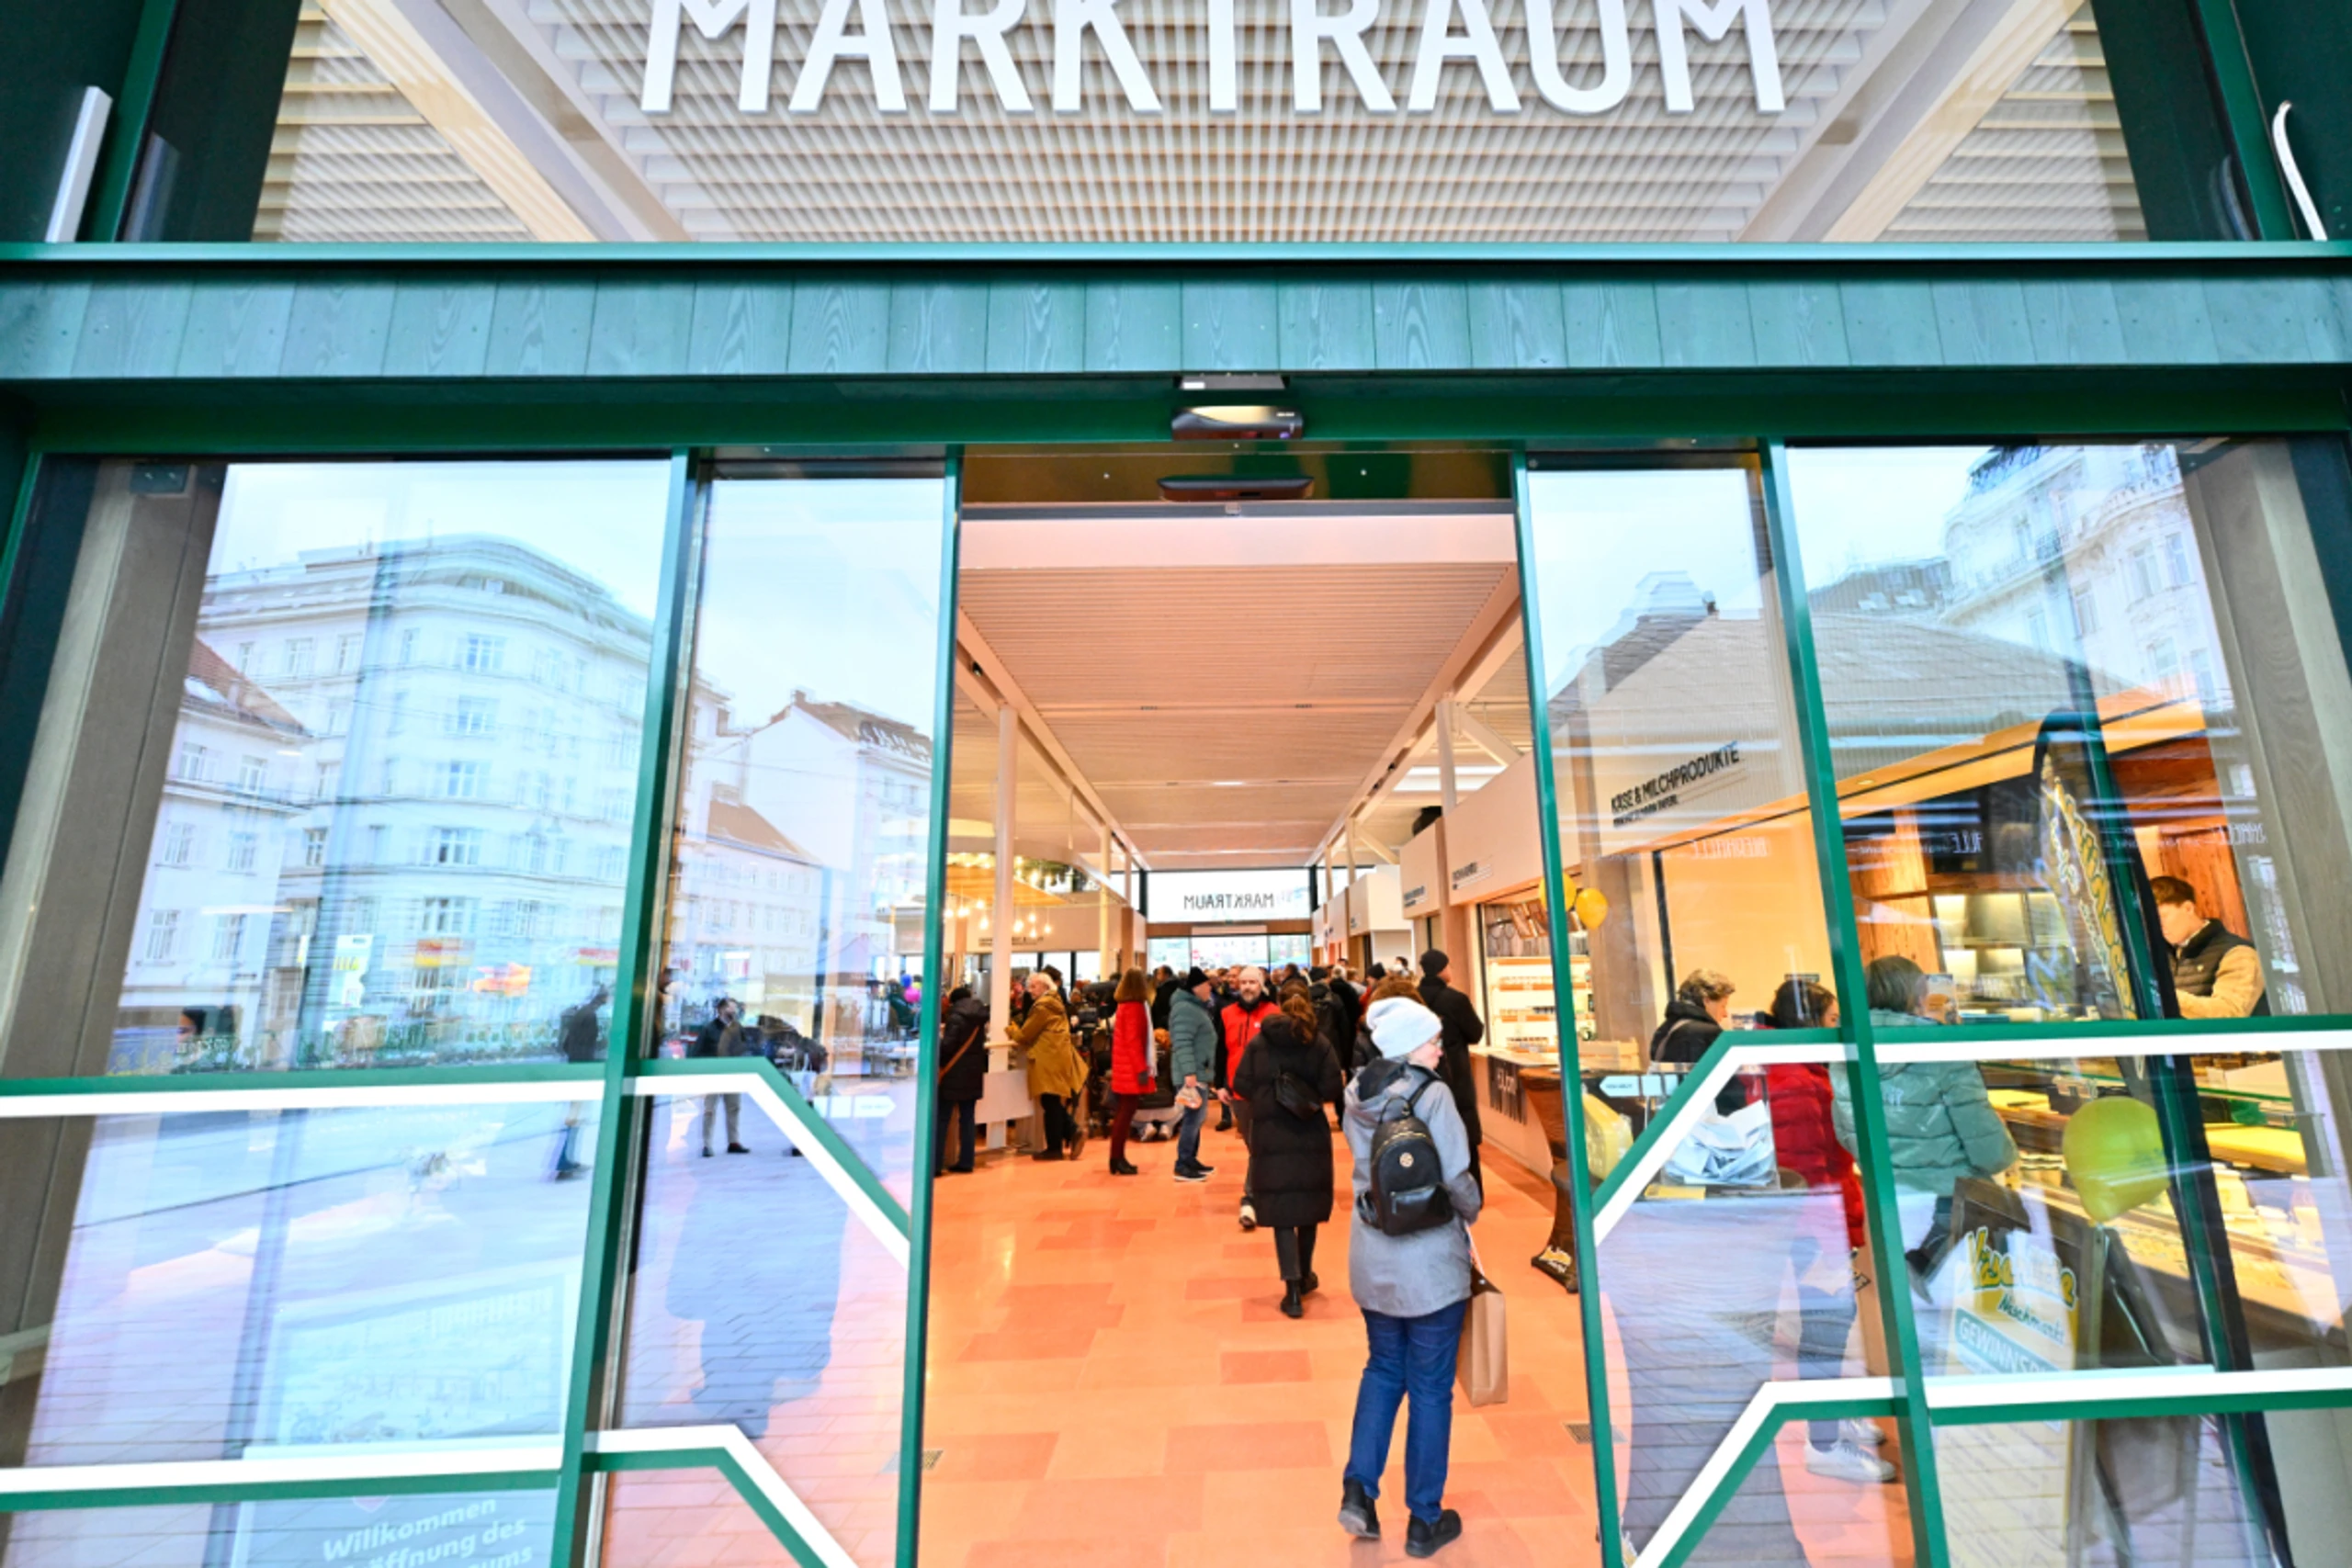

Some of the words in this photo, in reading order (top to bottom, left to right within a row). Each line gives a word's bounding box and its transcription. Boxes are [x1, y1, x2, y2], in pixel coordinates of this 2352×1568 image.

[1642, 740, 1740, 800] MILCHPRODUKTE
[322, 1498, 497, 1561] Willkommen
[482, 1517, 526, 1544] des
